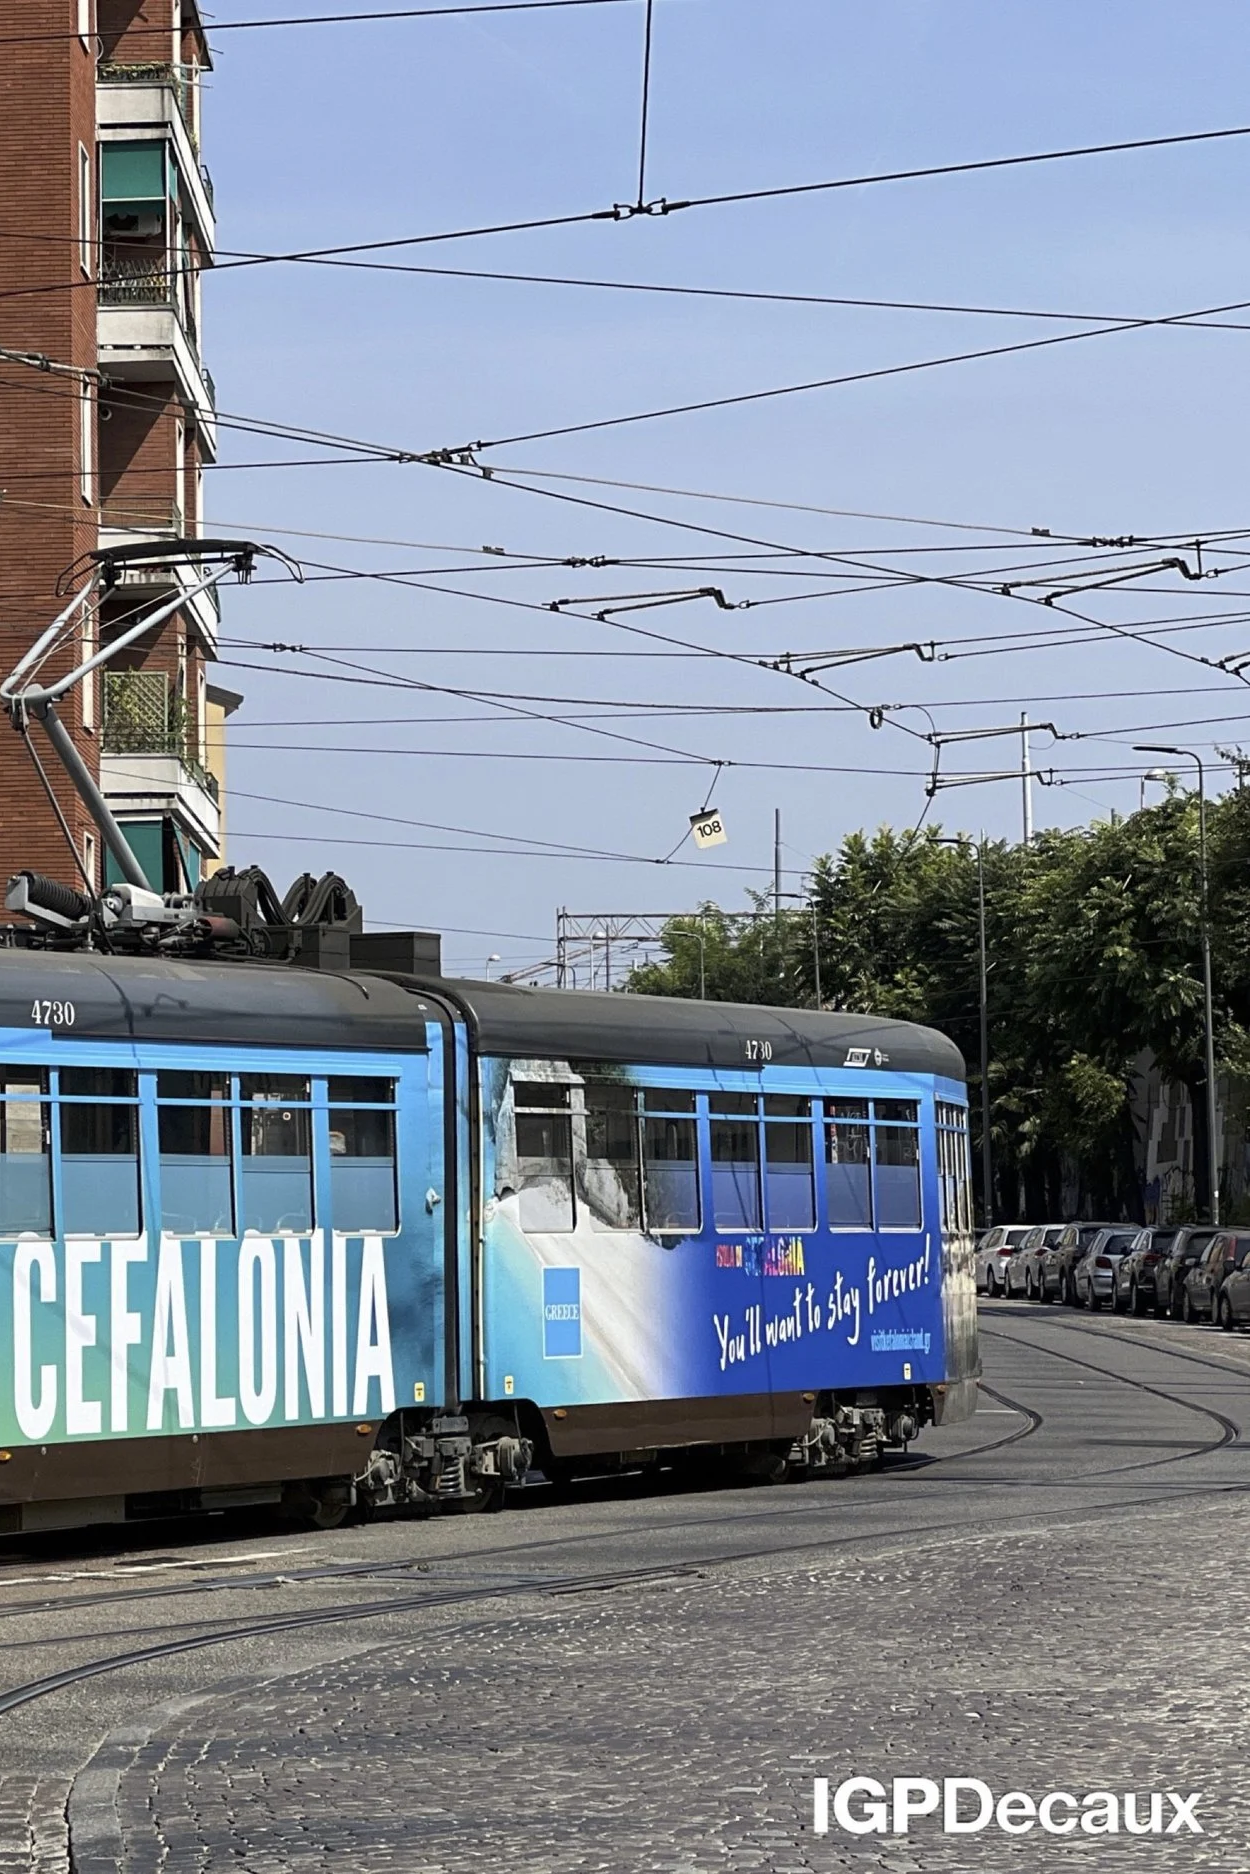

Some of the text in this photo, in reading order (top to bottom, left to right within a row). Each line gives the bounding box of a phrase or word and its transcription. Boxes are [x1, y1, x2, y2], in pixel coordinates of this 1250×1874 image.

[696, 820, 722, 838] 108
[31, 999, 76, 1026] 4730
[745, 1039, 773, 1061] 4730
[545, 1303, 580, 1321] GREECE
[713, 1232, 931, 1372] You'll want to stay forever!
[11, 1229, 397, 1441] CEFALONIA
